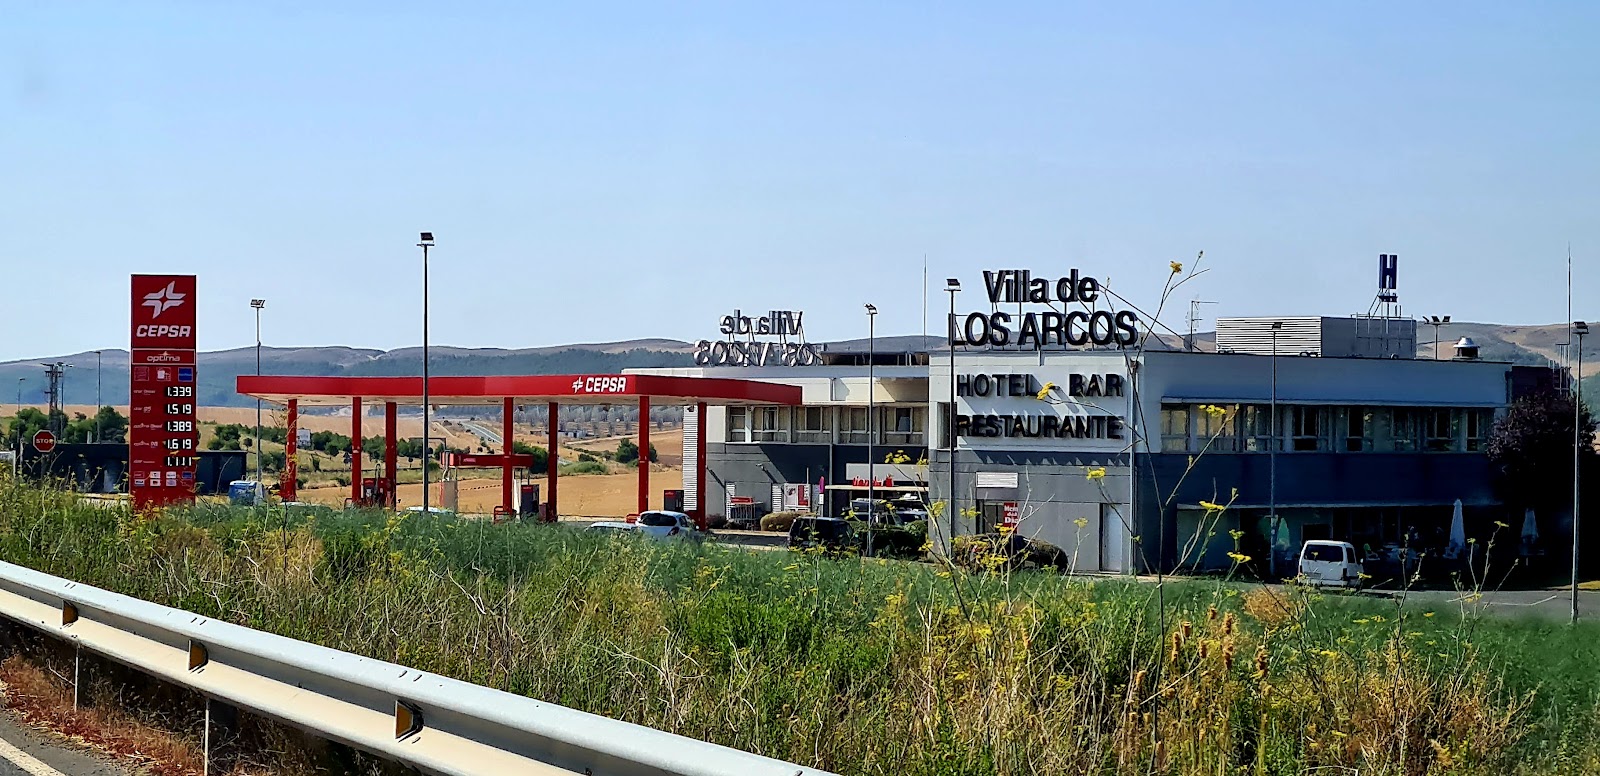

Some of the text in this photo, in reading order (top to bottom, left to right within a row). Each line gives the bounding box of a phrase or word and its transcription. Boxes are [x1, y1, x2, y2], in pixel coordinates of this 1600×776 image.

[1379, 254, 1397, 289] H
[983, 269, 1100, 303] Villa de
[136, 324, 191, 338] CEPSA
[948, 310, 1139, 346] LOS ARCOS
[146, 353, 181, 363] optima
[167, 386, 192, 397] 1.339
[585, 376, 627, 393] CEPSA
[956, 373, 1124, 397] HOTEL BAR
[167, 403, 192, 414] 1.519
[167, 421, 192, 432] 1.389
[956, 414, 1125, 439] RESTAURANTE
[167, 438, 192, 449] 1.619
